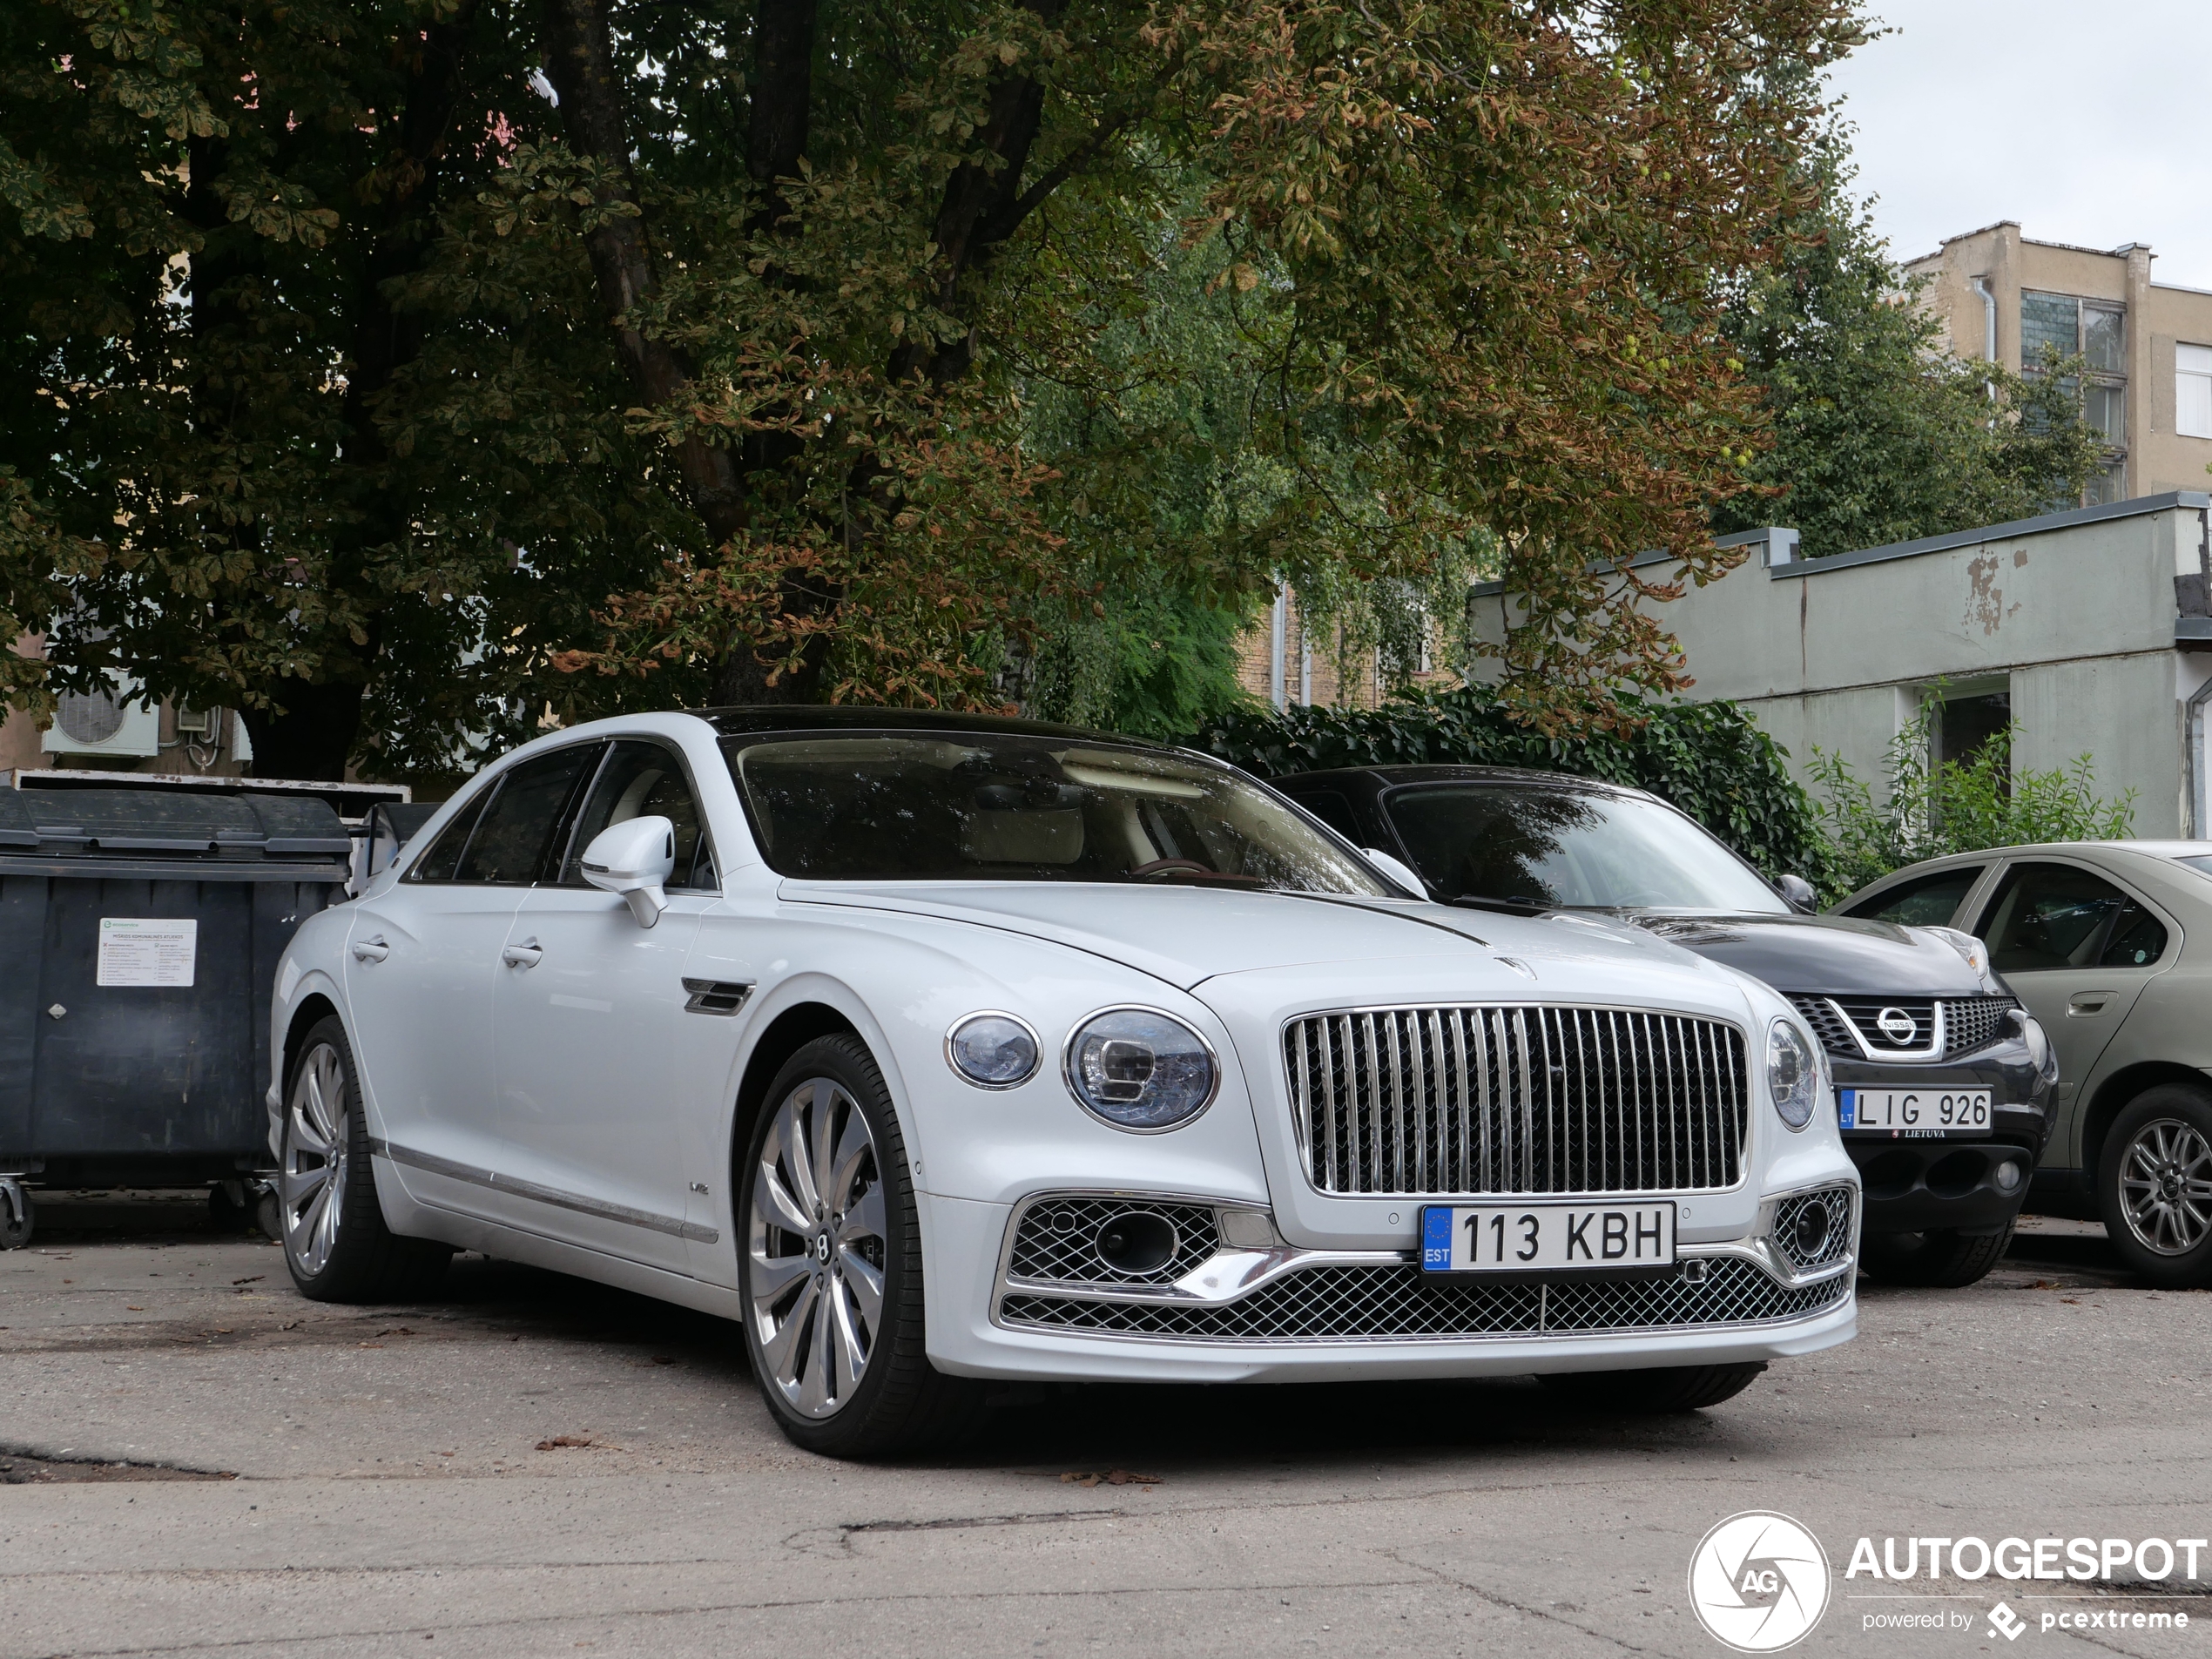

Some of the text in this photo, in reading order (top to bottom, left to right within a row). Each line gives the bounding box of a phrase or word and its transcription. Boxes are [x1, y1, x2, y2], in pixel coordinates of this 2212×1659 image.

[1858, 1094, 1986, 1125] LIG 926
[1841, 1114, 1853, 1123] LT
[1905, 1130, 1946, 1138] LIETUVA
[1464, 1210, 1662, 1262] 113 KBH
[1425, 1249, 1450, 1262] EST
